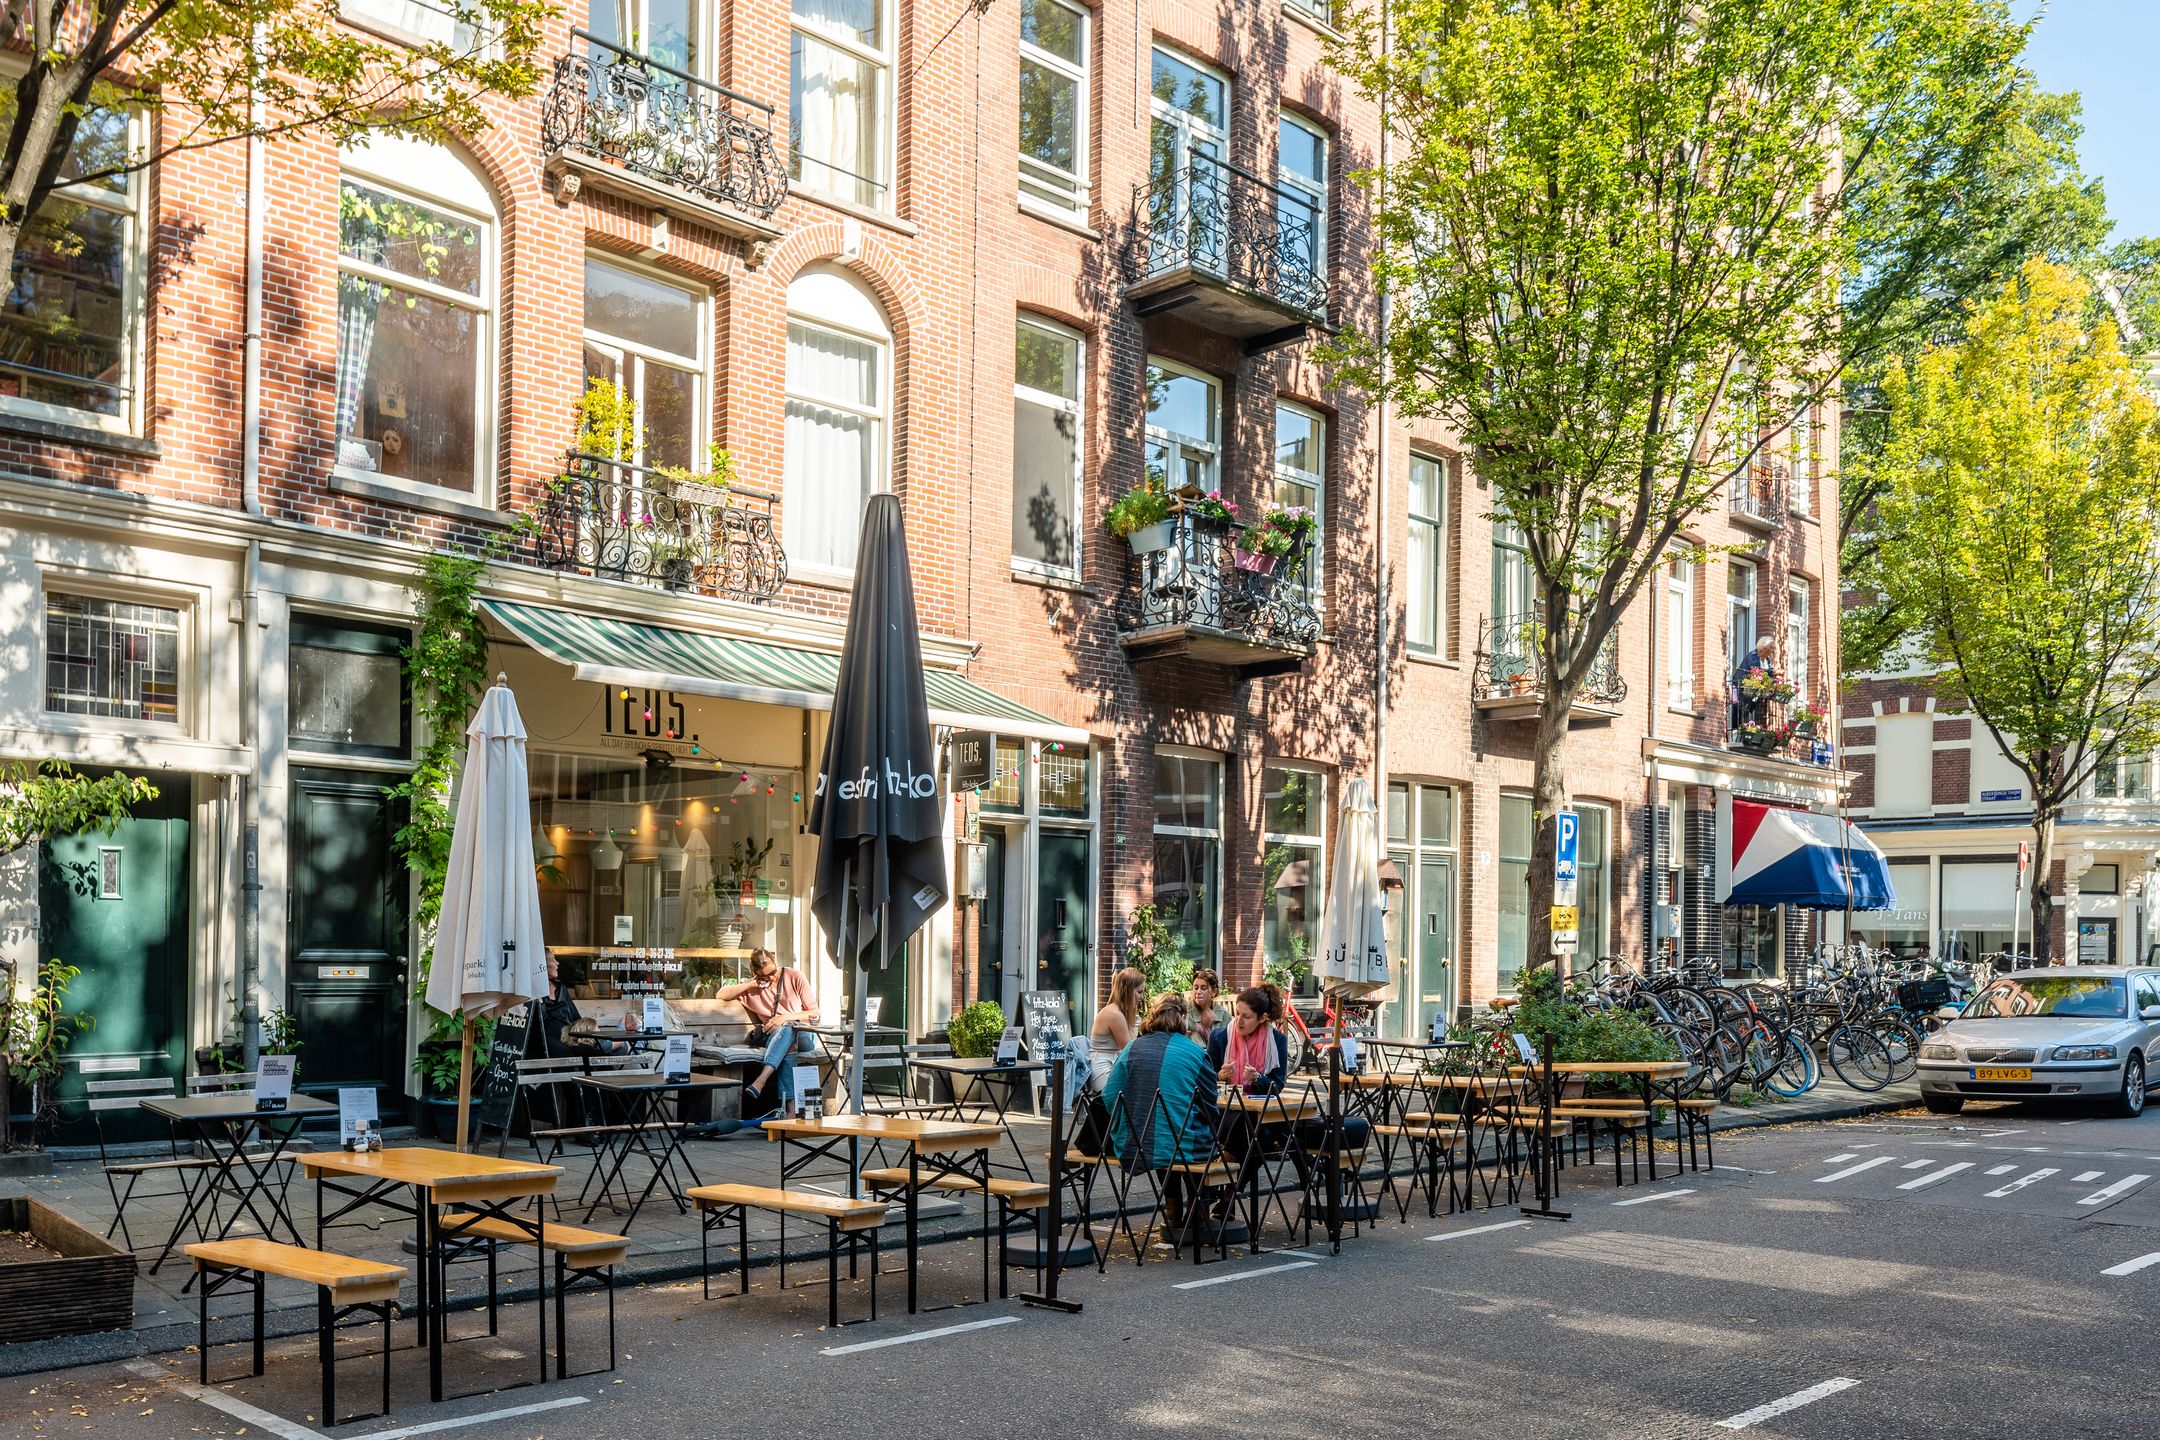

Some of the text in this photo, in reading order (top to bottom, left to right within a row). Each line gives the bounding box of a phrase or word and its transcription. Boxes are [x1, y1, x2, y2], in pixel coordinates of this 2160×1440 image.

[960, 741, 982, 763] TEDS.
[1562, 817, 1575, 853] P
[494, 1063, 509, 1082] Open
